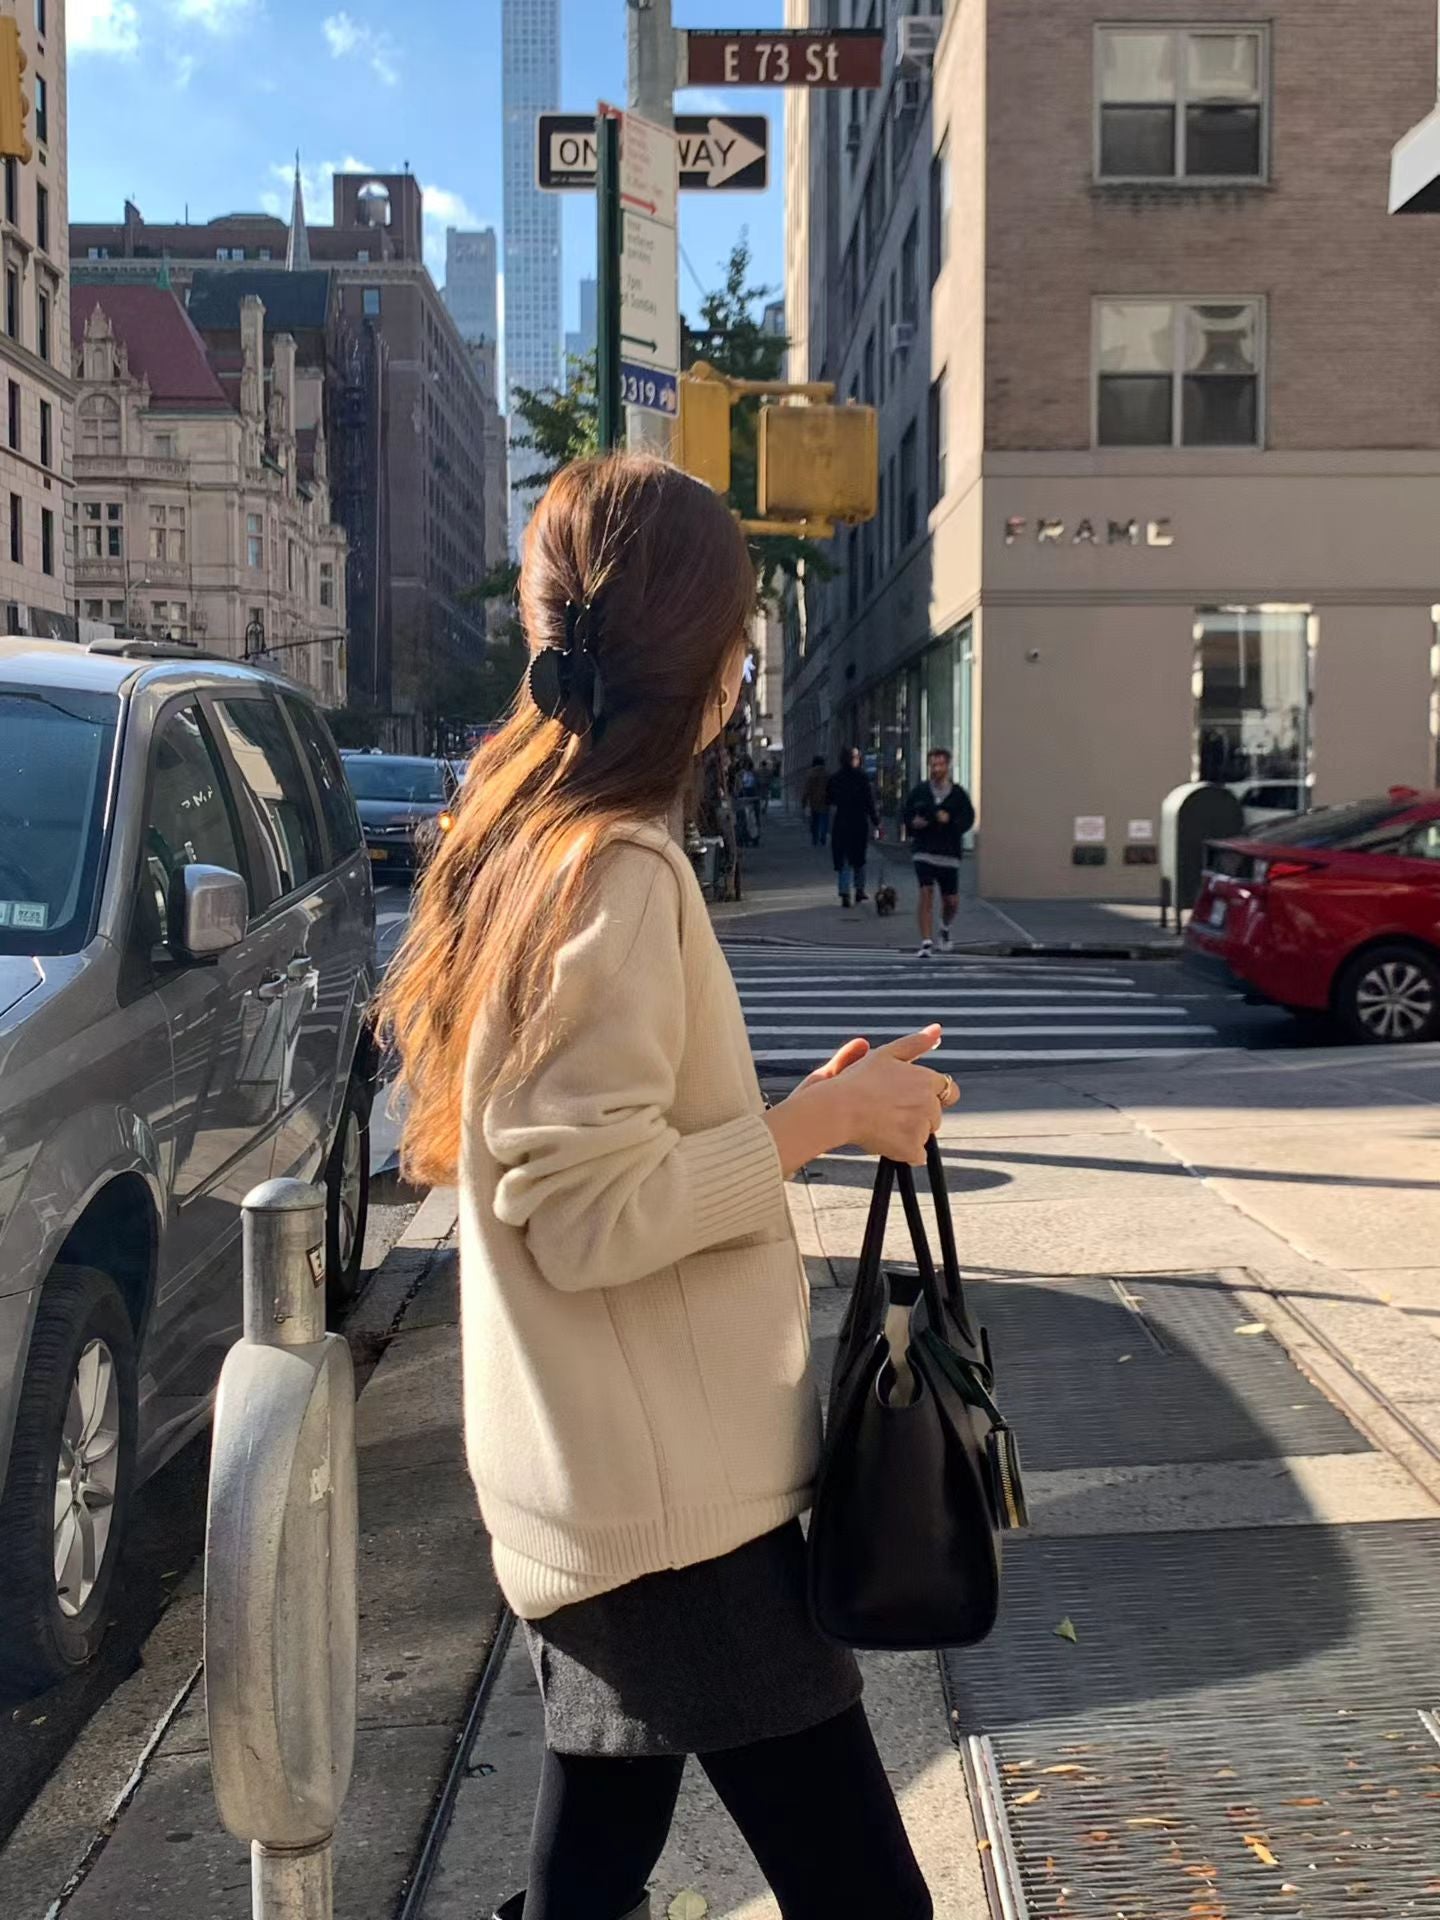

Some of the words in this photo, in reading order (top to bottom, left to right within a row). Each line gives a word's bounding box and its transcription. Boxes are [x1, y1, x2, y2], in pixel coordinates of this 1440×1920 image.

[724, 43, 740, 82] E
[755, 43, 790, 82] 73
[806, 42, 839, 82] St
[560, 138, 598, 167] ON
[1005, 515, 1175, 546] FRAME
